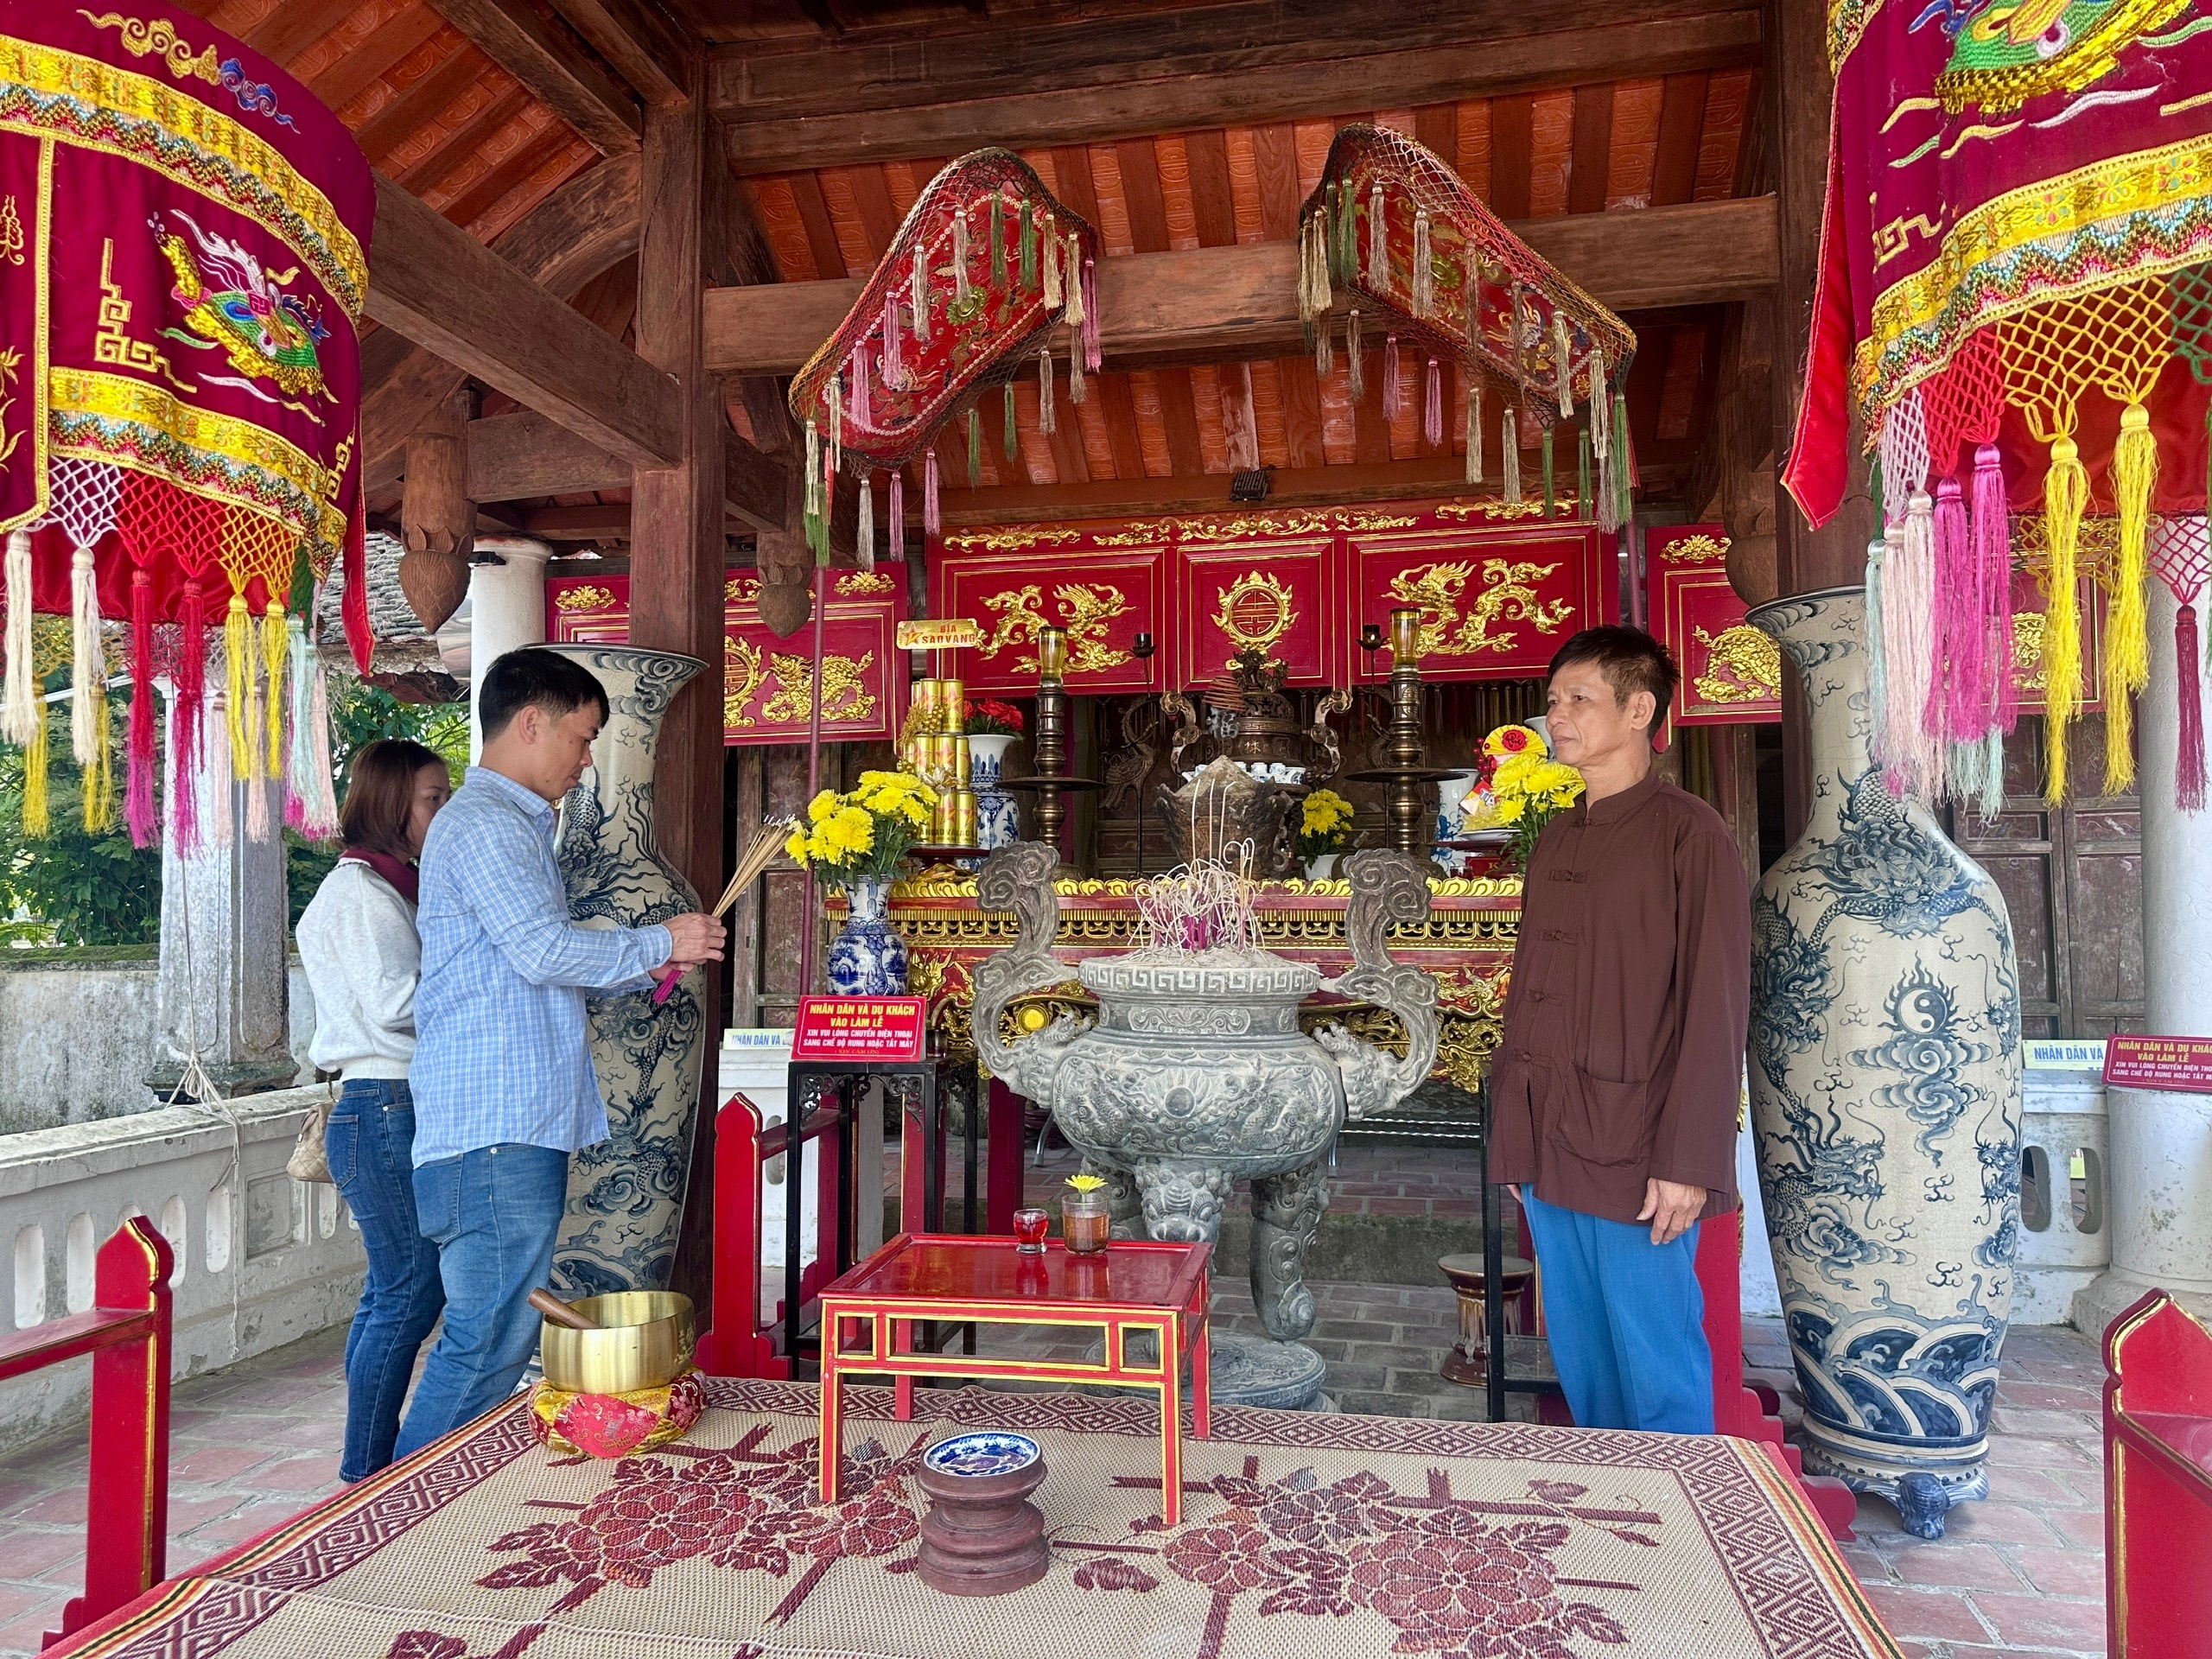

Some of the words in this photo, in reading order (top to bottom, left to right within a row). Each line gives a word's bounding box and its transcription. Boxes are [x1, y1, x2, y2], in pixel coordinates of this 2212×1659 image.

[810, 1004, 834, 1014] NHÂN
[836, 1003, 855, 1014] DÂN
[857, 1003, 868, 1014] VÀ
[871, 1006, 883, 1014] DU
[886, 1004, 915, 1015] KHÁCH
[830, 1016, 848, 1027] VÀO
[850, 1017, 869, 1027] LÀM
[754, 1033, 769, 1045] DÂN
[823, 1037, 836, 1046] CHẾ
[2034, 1045, 2063, 1059] NHÂN
[2066, 1045, 2088, 1059] DÂN
[2090, 1045, 2104, 1059] VÀ
[2118, 1040, 2140, 1050] NHÂN
[2143, 1041, 2160, 1051] DÂN
[2164, 1042, 2174, 1052] VÀ
[2177, 1044, 2190, 1052] DU
[2192, 1044, 2212, 1053] KHÁC
[2138, 1052, 2154, 1061] VÀO
[2157, 1052, 2176, 1062] LÀM
